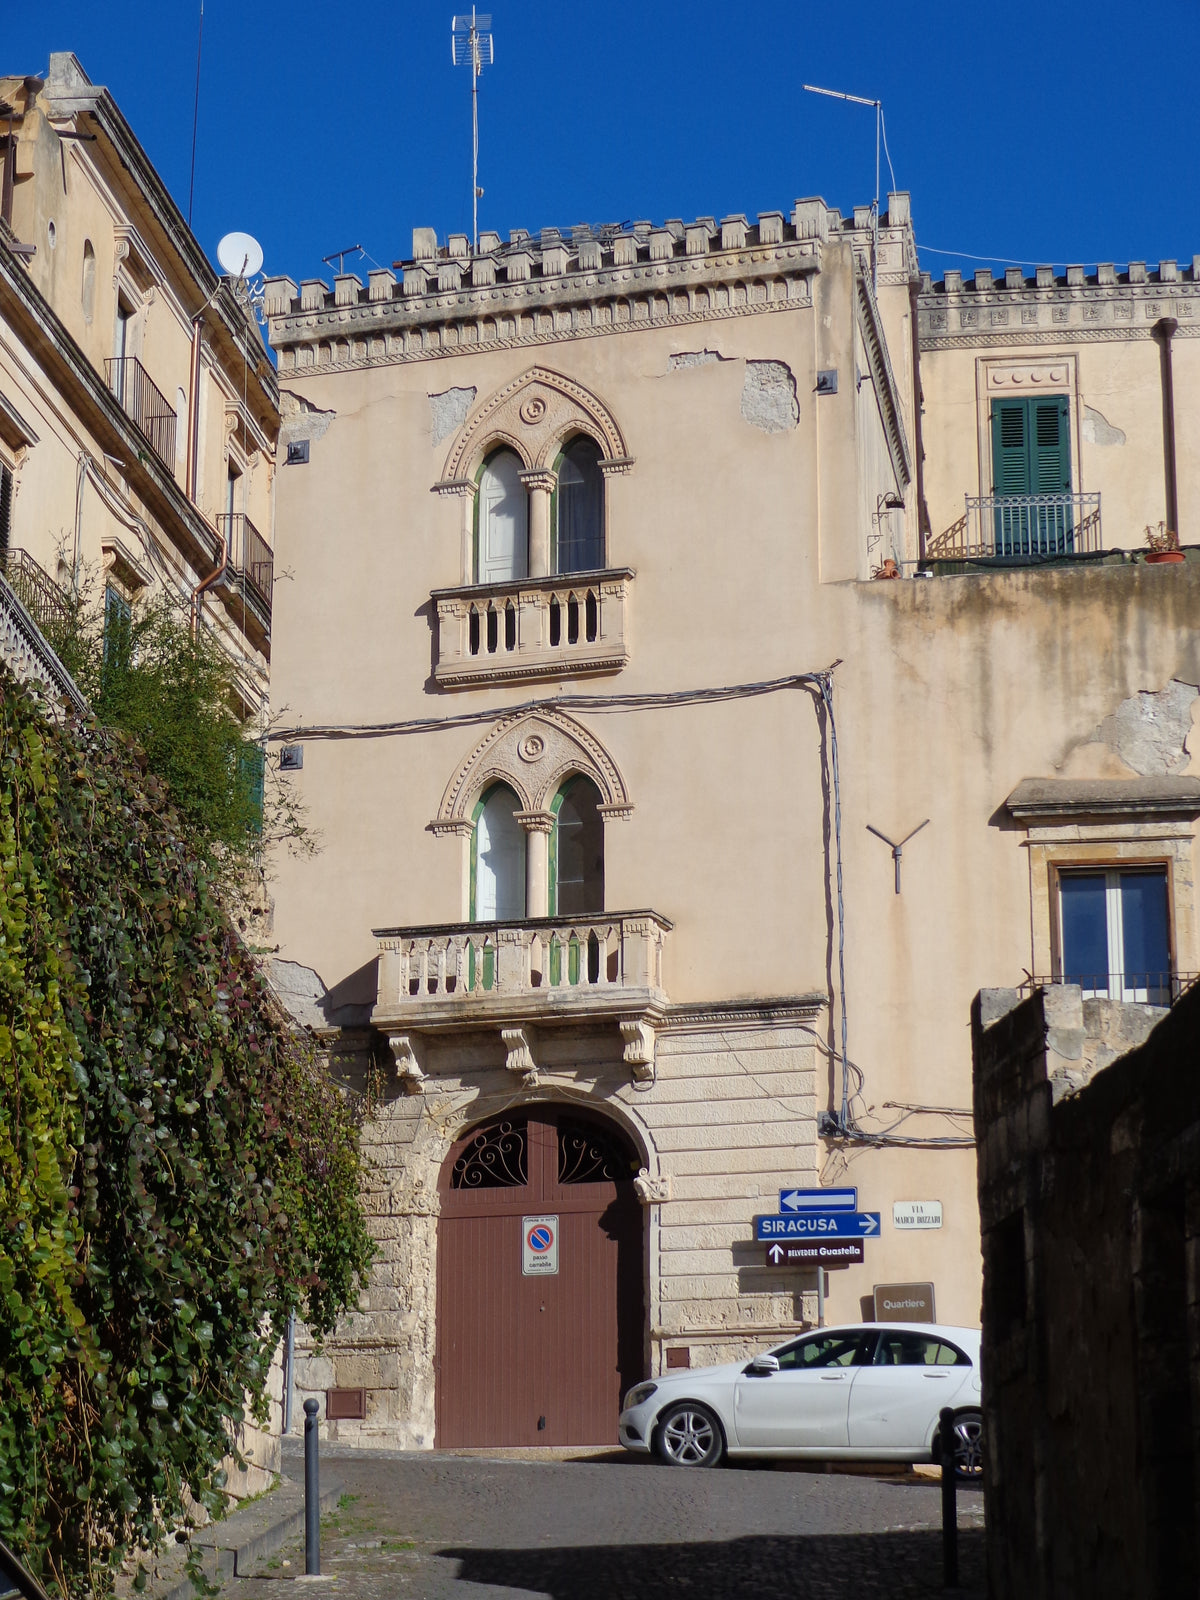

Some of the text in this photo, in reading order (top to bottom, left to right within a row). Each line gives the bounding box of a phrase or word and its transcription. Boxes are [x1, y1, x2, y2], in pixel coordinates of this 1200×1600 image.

[912, 1205, 924, 1214] VIA
[762, 1218, 838, 1232] SIRACUSA
[895, 1216, 914, 1224] MARCO
[788, 1246, 860, 1257] BELVEDERE Guastella
[883, 1299, 925, 1310] Quartiere
